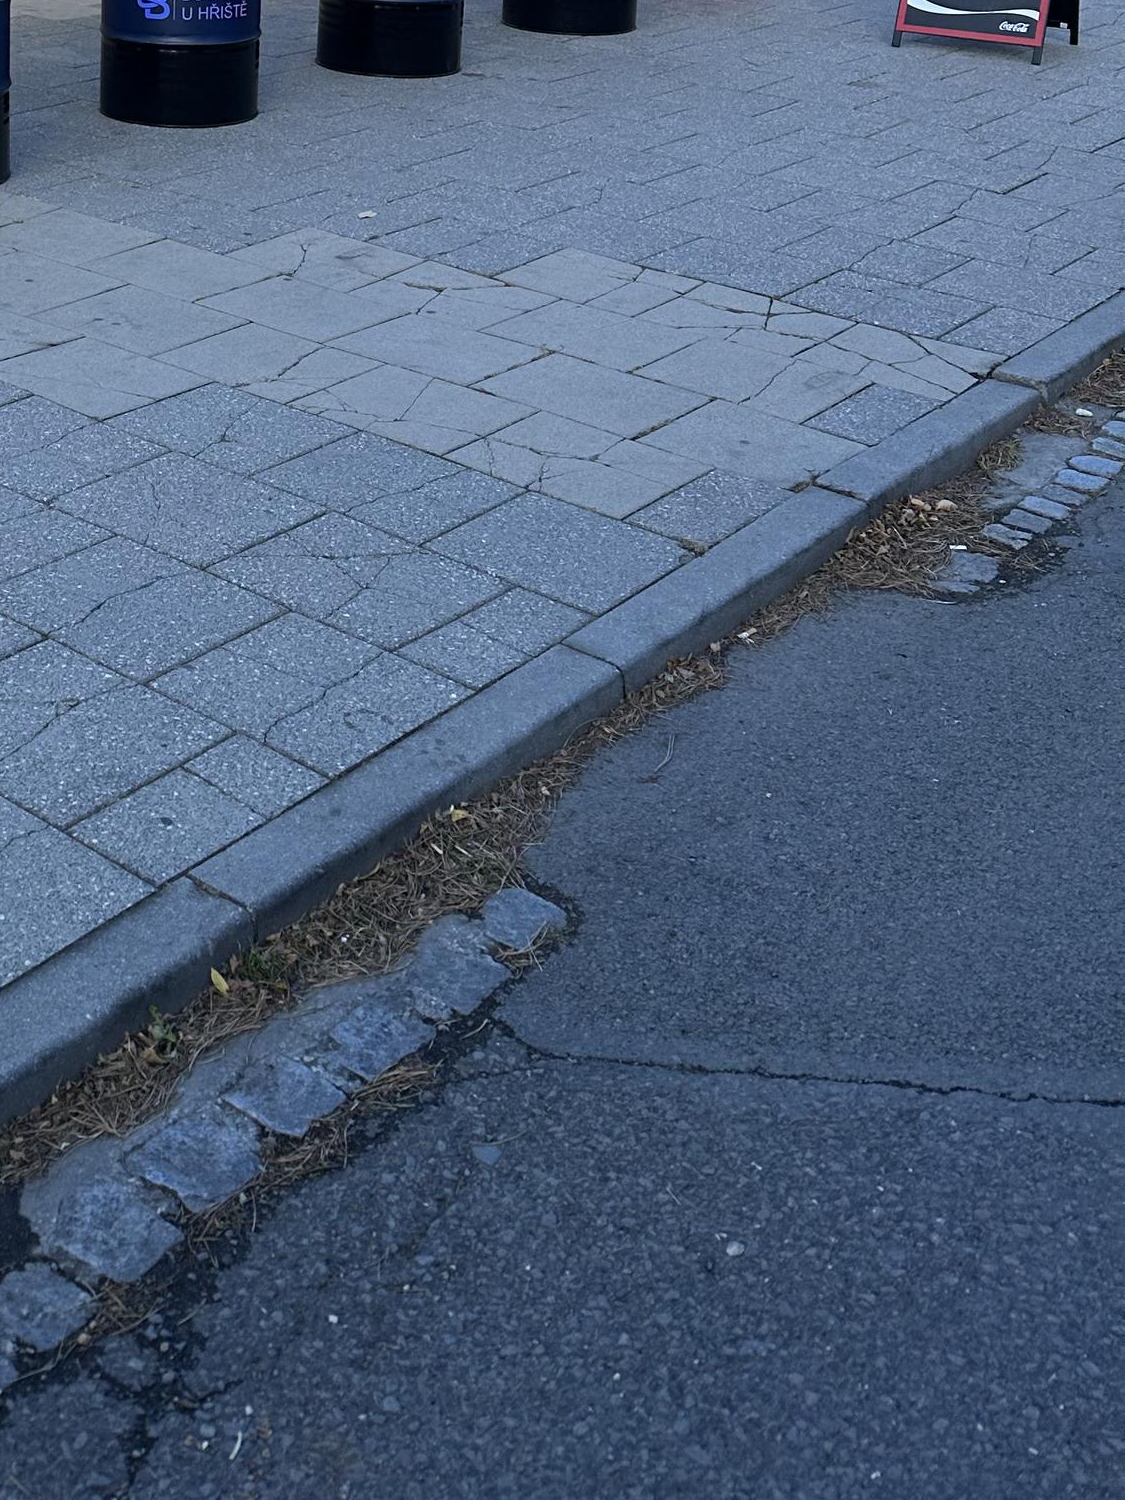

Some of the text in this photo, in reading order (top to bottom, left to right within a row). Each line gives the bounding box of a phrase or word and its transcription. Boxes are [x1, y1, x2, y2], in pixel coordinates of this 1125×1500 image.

[182, 0, 248, 21] U HŘIŠTĚ
[998, 20, 1031, 33] Coca-Cola
